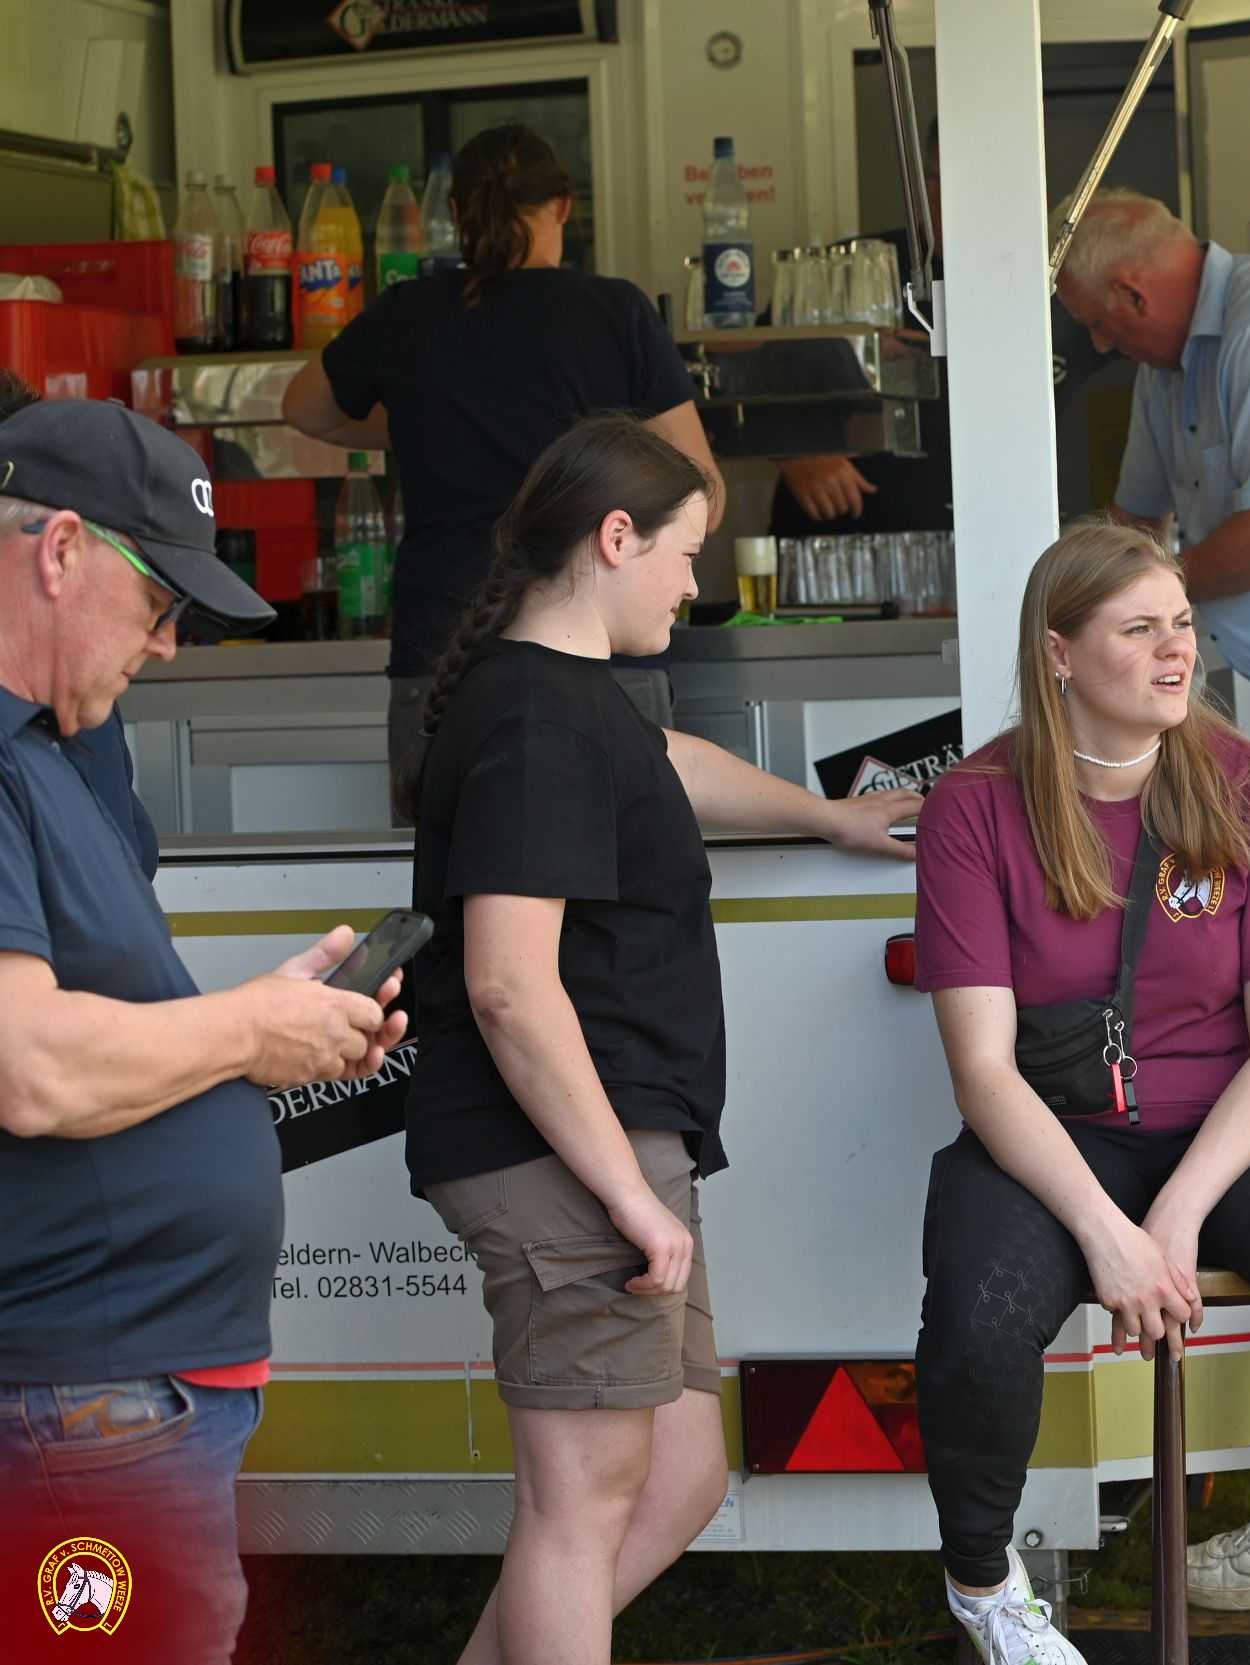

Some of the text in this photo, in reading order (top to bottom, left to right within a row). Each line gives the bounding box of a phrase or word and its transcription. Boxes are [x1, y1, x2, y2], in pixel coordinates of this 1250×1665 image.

[277, 1243, 361, 1265] eldern-
[272, 1274, 467, 1299] Tel. 02831-5544
